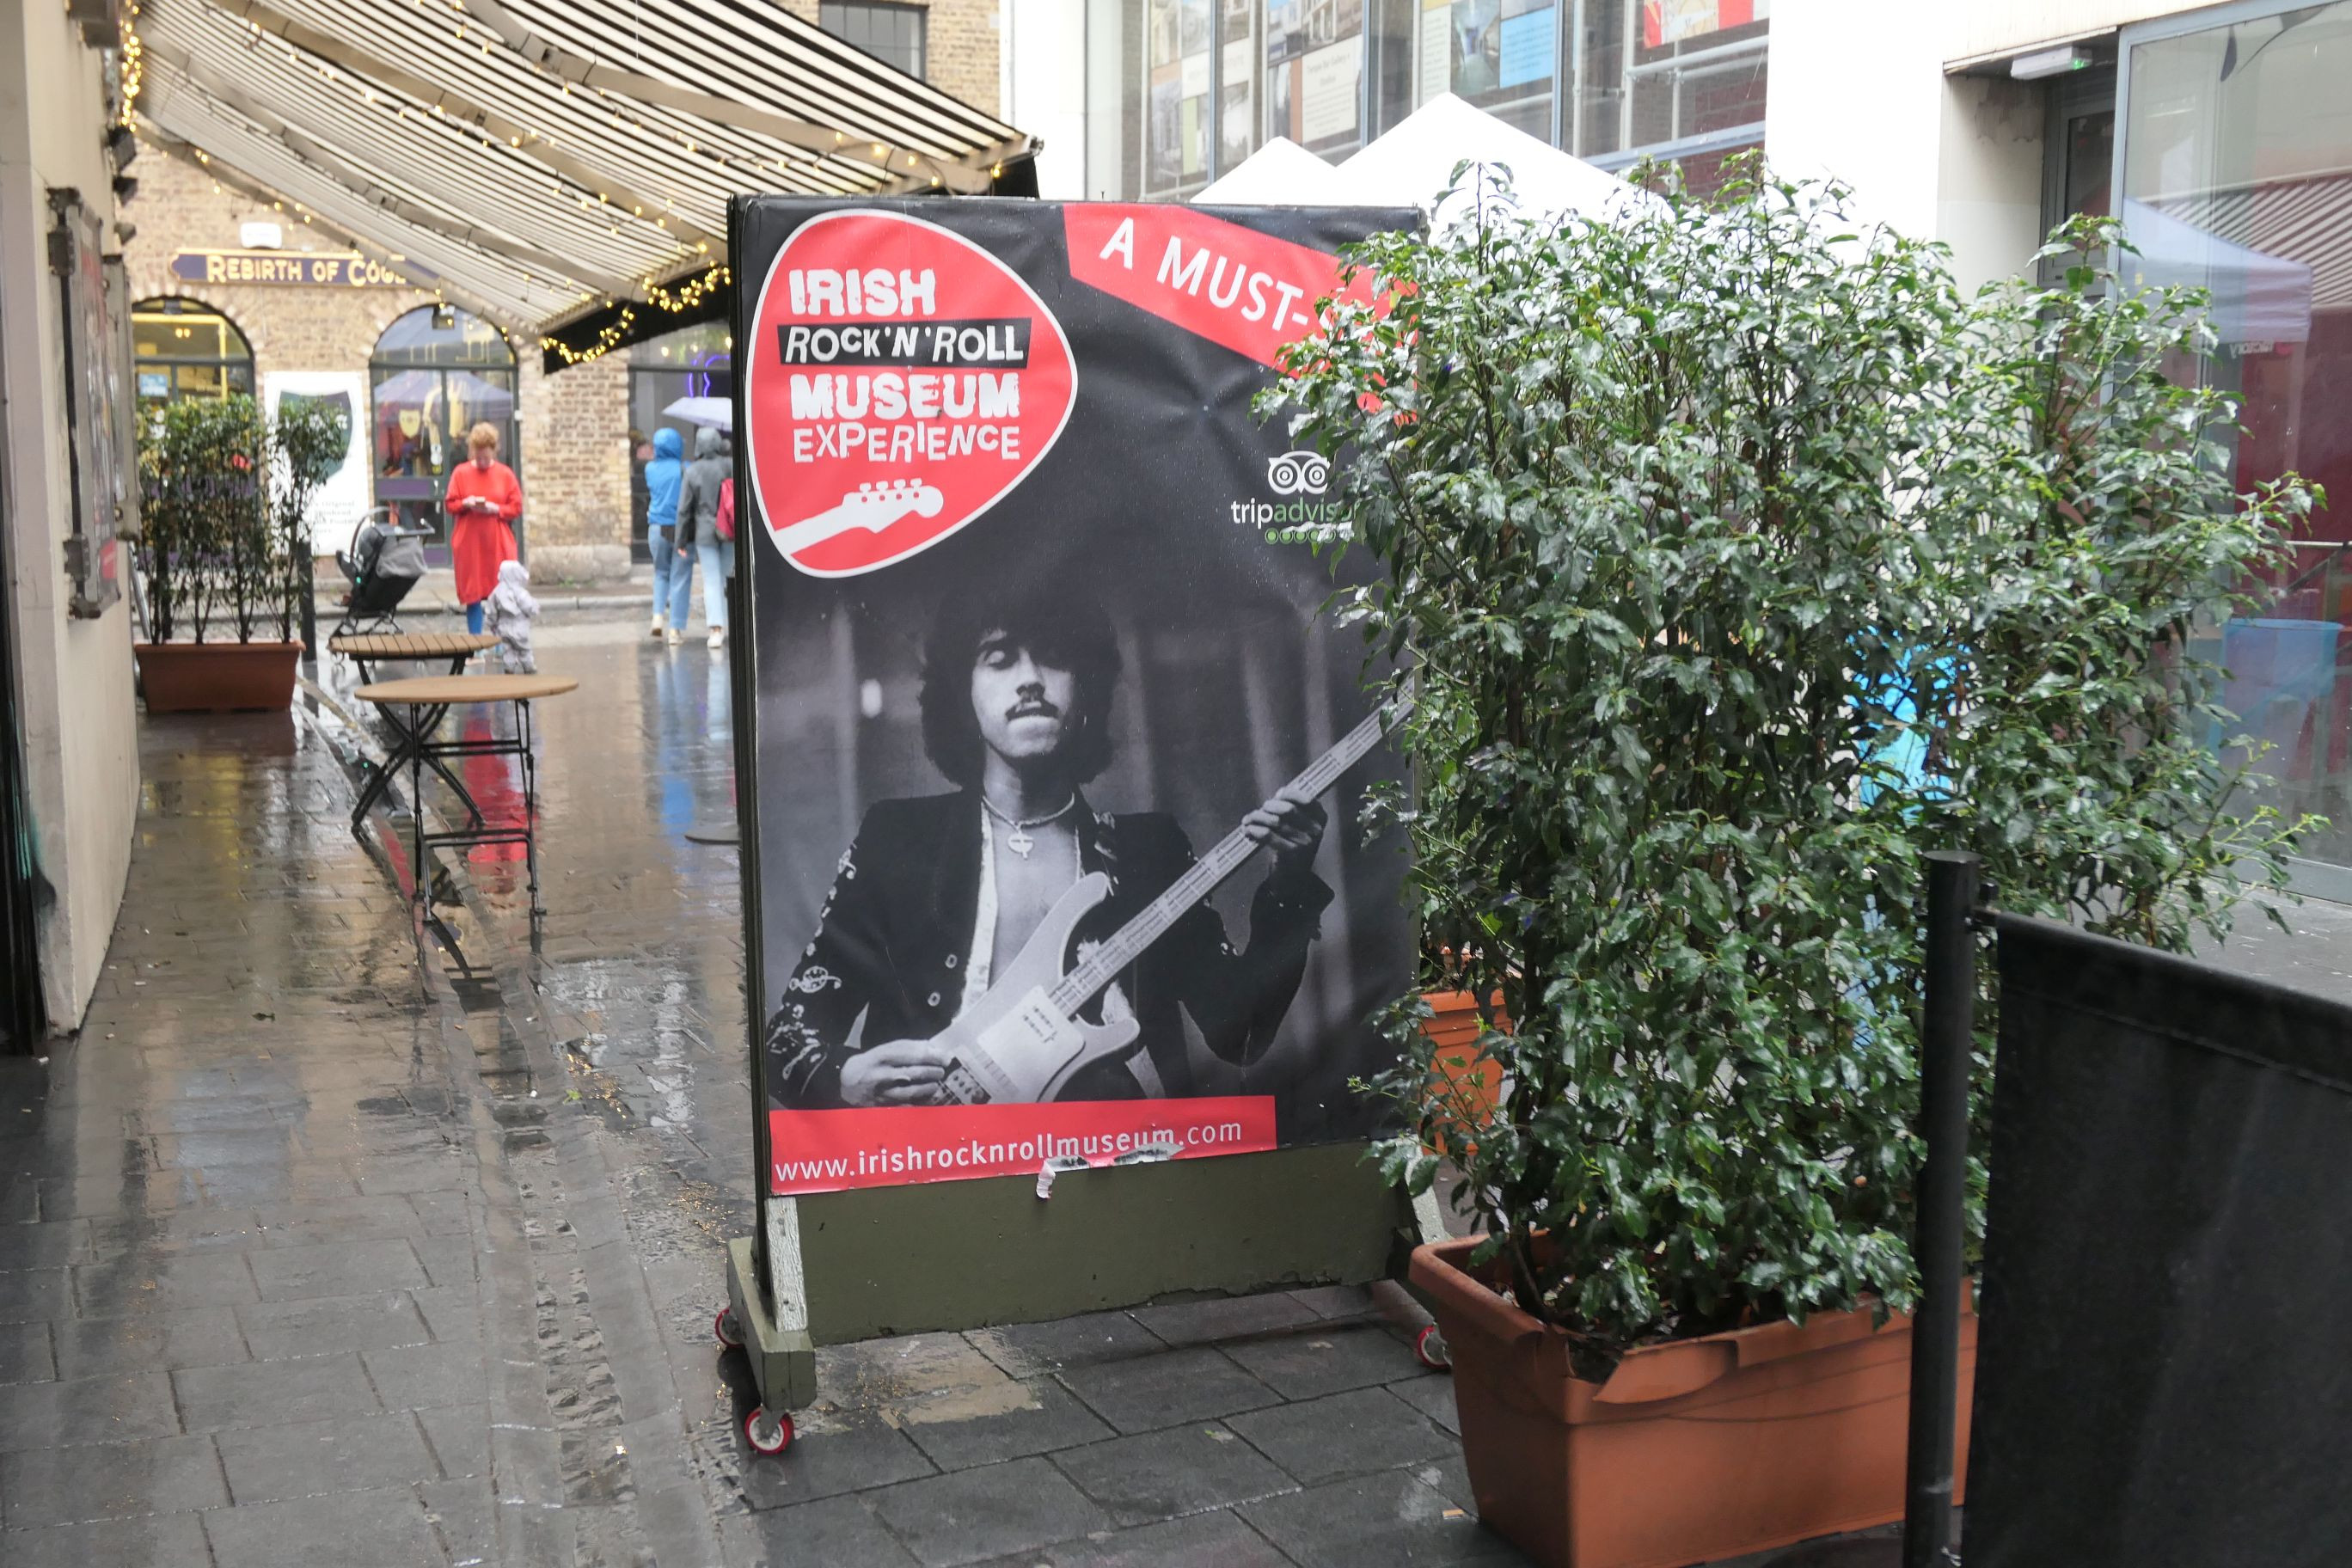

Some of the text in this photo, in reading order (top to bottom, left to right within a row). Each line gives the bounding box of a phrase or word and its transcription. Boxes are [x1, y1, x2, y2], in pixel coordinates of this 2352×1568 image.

[312, 260, 340, 282] OF
[789, 268, 936, 316] IRISH
[1099, 217, 1336, 331] A MUST-
[790, 372, 1020, 420] MUSEUM
[793, 421, 1020, 463] EXPERIENCE
[775, 1122, 1241, 1182] www.irishrocknrollmuseum.com
